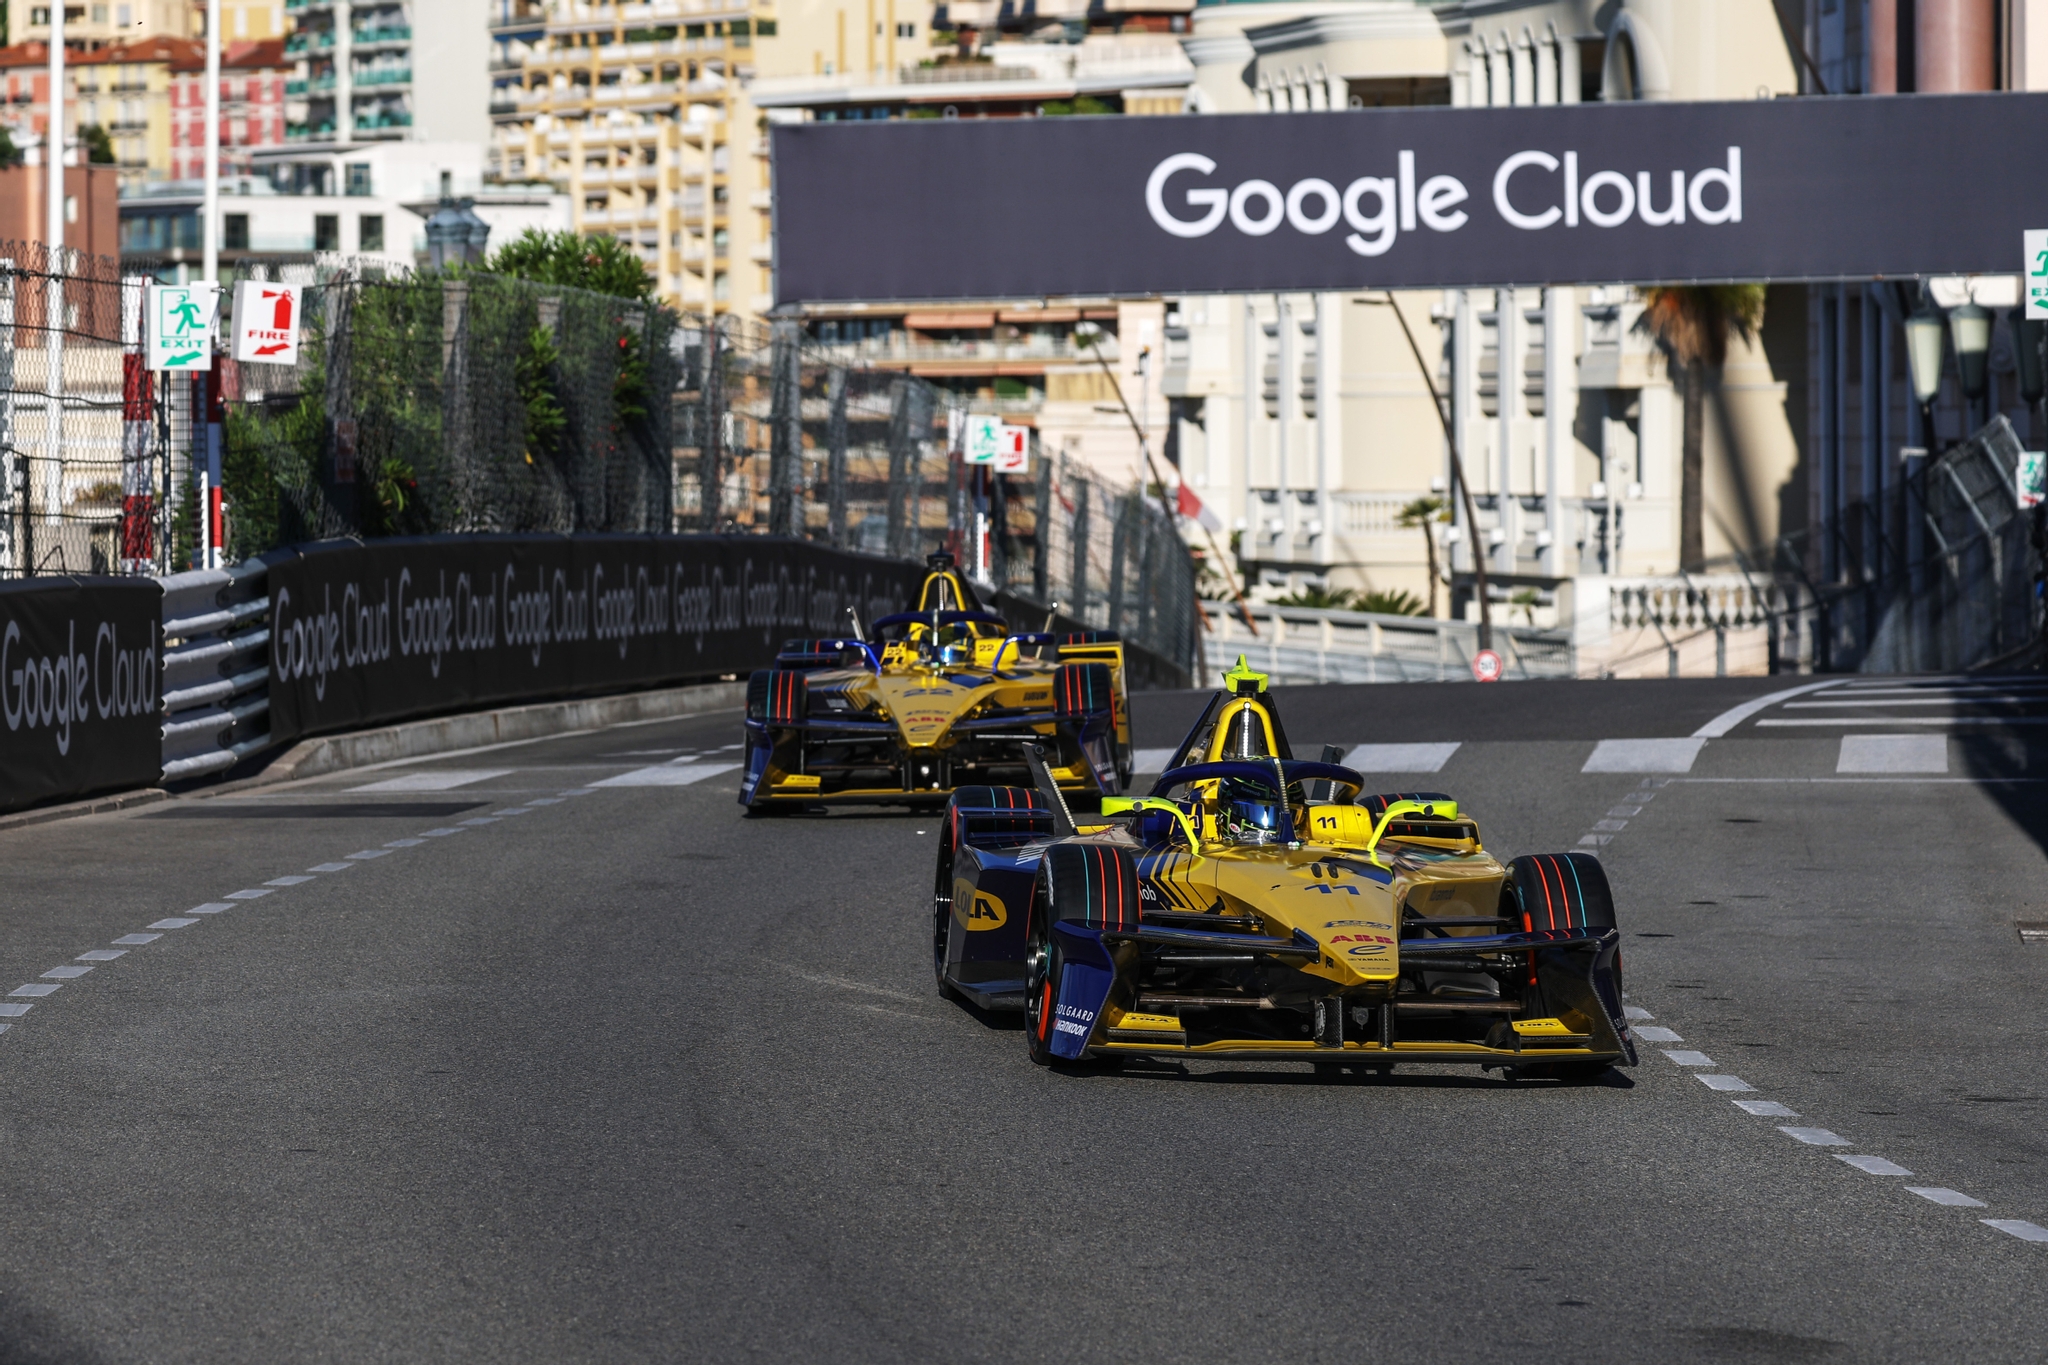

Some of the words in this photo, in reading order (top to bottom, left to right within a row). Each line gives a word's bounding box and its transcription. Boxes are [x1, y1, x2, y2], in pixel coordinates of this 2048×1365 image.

[1145, 149, 1469, 257] Google
[1492, 145, 1743, 229] Cloud
[161, 340, 205, 348] EXIT
[248, 330, 291, 340] FIRE
[398, 566, 453, 679] Google
[455, 571, 497, 651] Cloud
[503, 562, 551, 668] Google
[274, 585, 340, 702] Google
[343, 578, 390, 668] Cloud
[979, 644, 995, 652] 22
[2, 619, 90, 757] Google
[94, 619, 156, 720] Cloud
[903, 687, 954, 698] 22
[1316, 816, 1338, 829] 11
[1140, 884, 1157, 902] ob
[1304, 884, 1360, 895] 11
[954, 885, 1001, 921] LOLA
[1330, 934, 1395, 945] ABB
[1055, 1003, 1094, 1022] SOLGAARD
